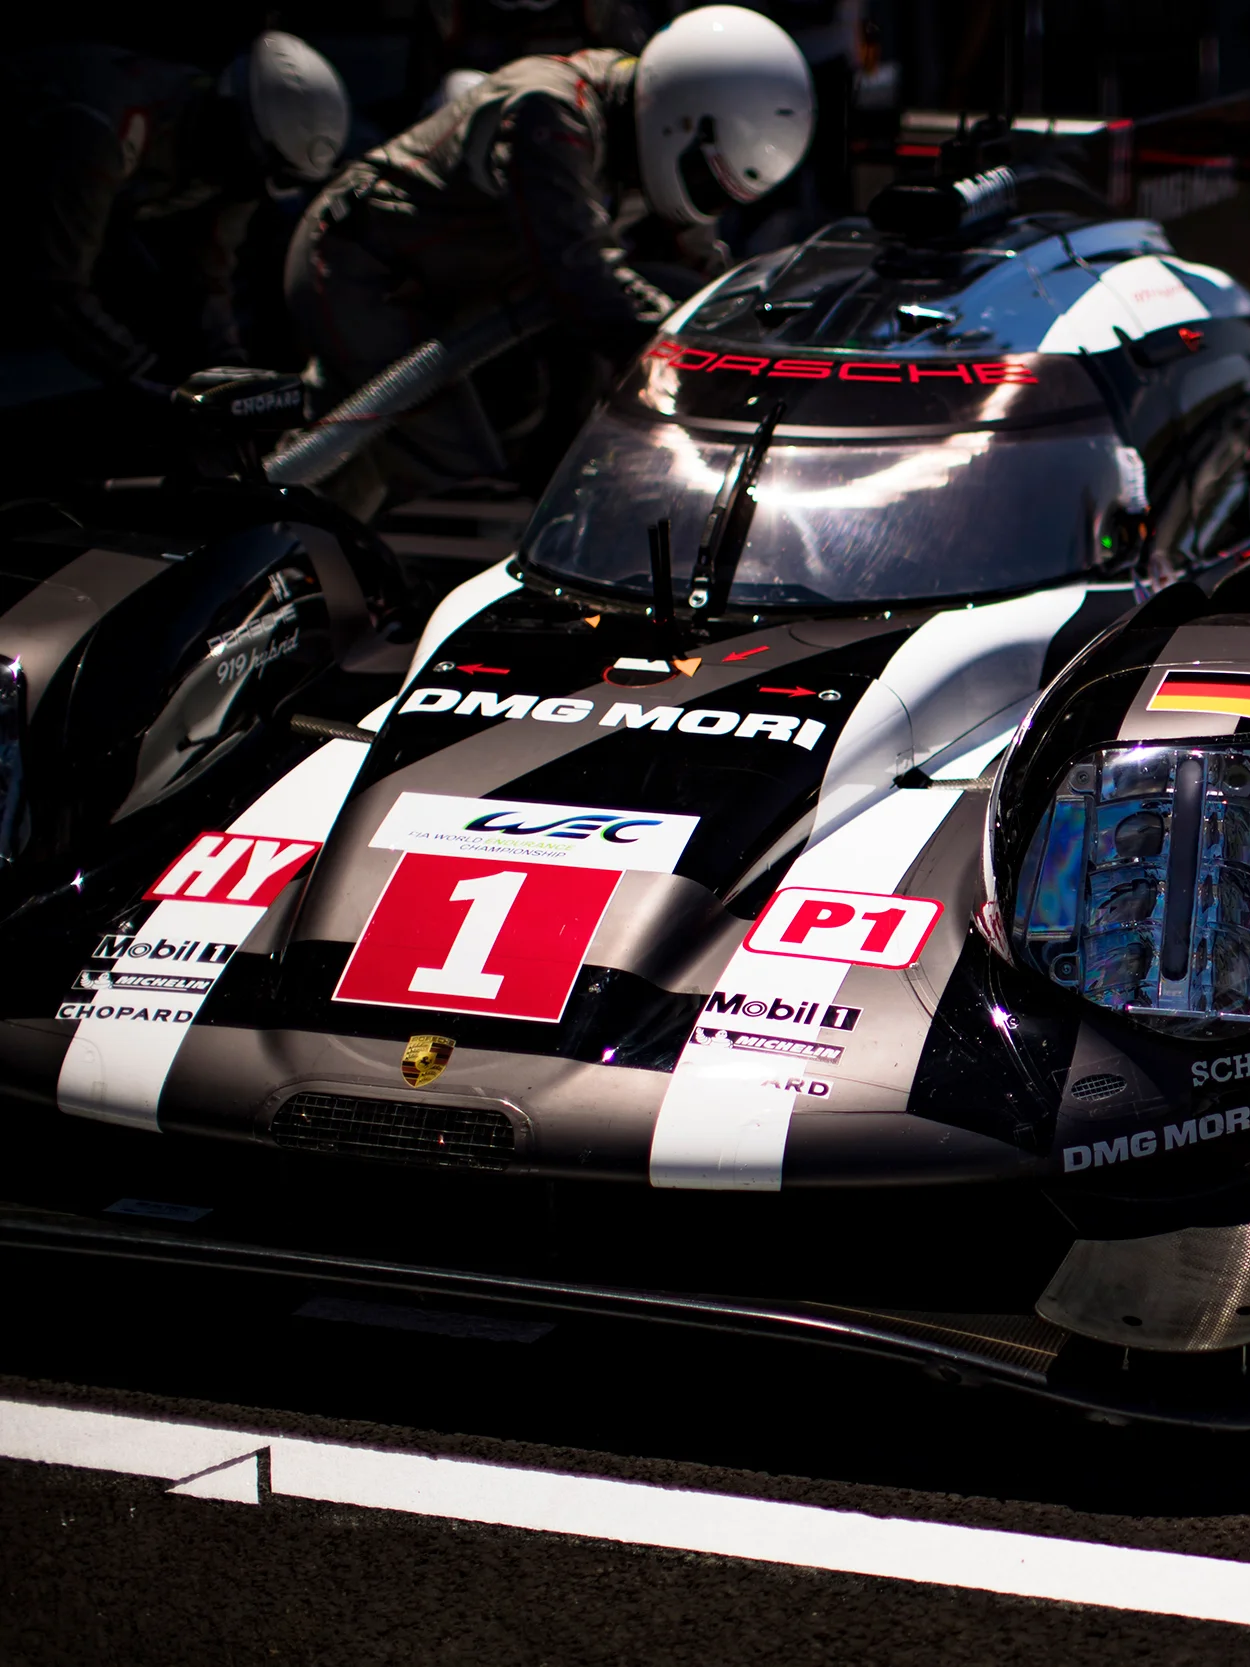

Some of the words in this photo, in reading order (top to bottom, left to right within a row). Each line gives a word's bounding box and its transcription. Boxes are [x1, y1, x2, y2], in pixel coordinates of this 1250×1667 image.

[645, 340, 1039, 385] PORSCHE
[216, 652, 248, 685] 919
[248, 626, 300, 680] hybrid
[398, 688, 594, 723] DMG
[599, 702, 827, 751] MORI
[433, 834, 484, 844] WORLD
[484, 838, 577, 852] ENDURANCE
[463, 811, 663, 844] WEC
[152, 835, 315, 900] HY
[459, 844, 567, 859] CHAMPIONSHIP
[408, 871, 528, 999] 1
[779, 899, 907, 953] P1
[93, 936, 201, 962] Mobil
[115, 974, 214, 990] MICHELIN
[58, 1004, 194, 1023] CHOPARD
[705, 991, 820, 1025] Mobil
[735, 1035, 842, 1059] MICHELIN
[1063, 1130, 1158, 1174] DMG
